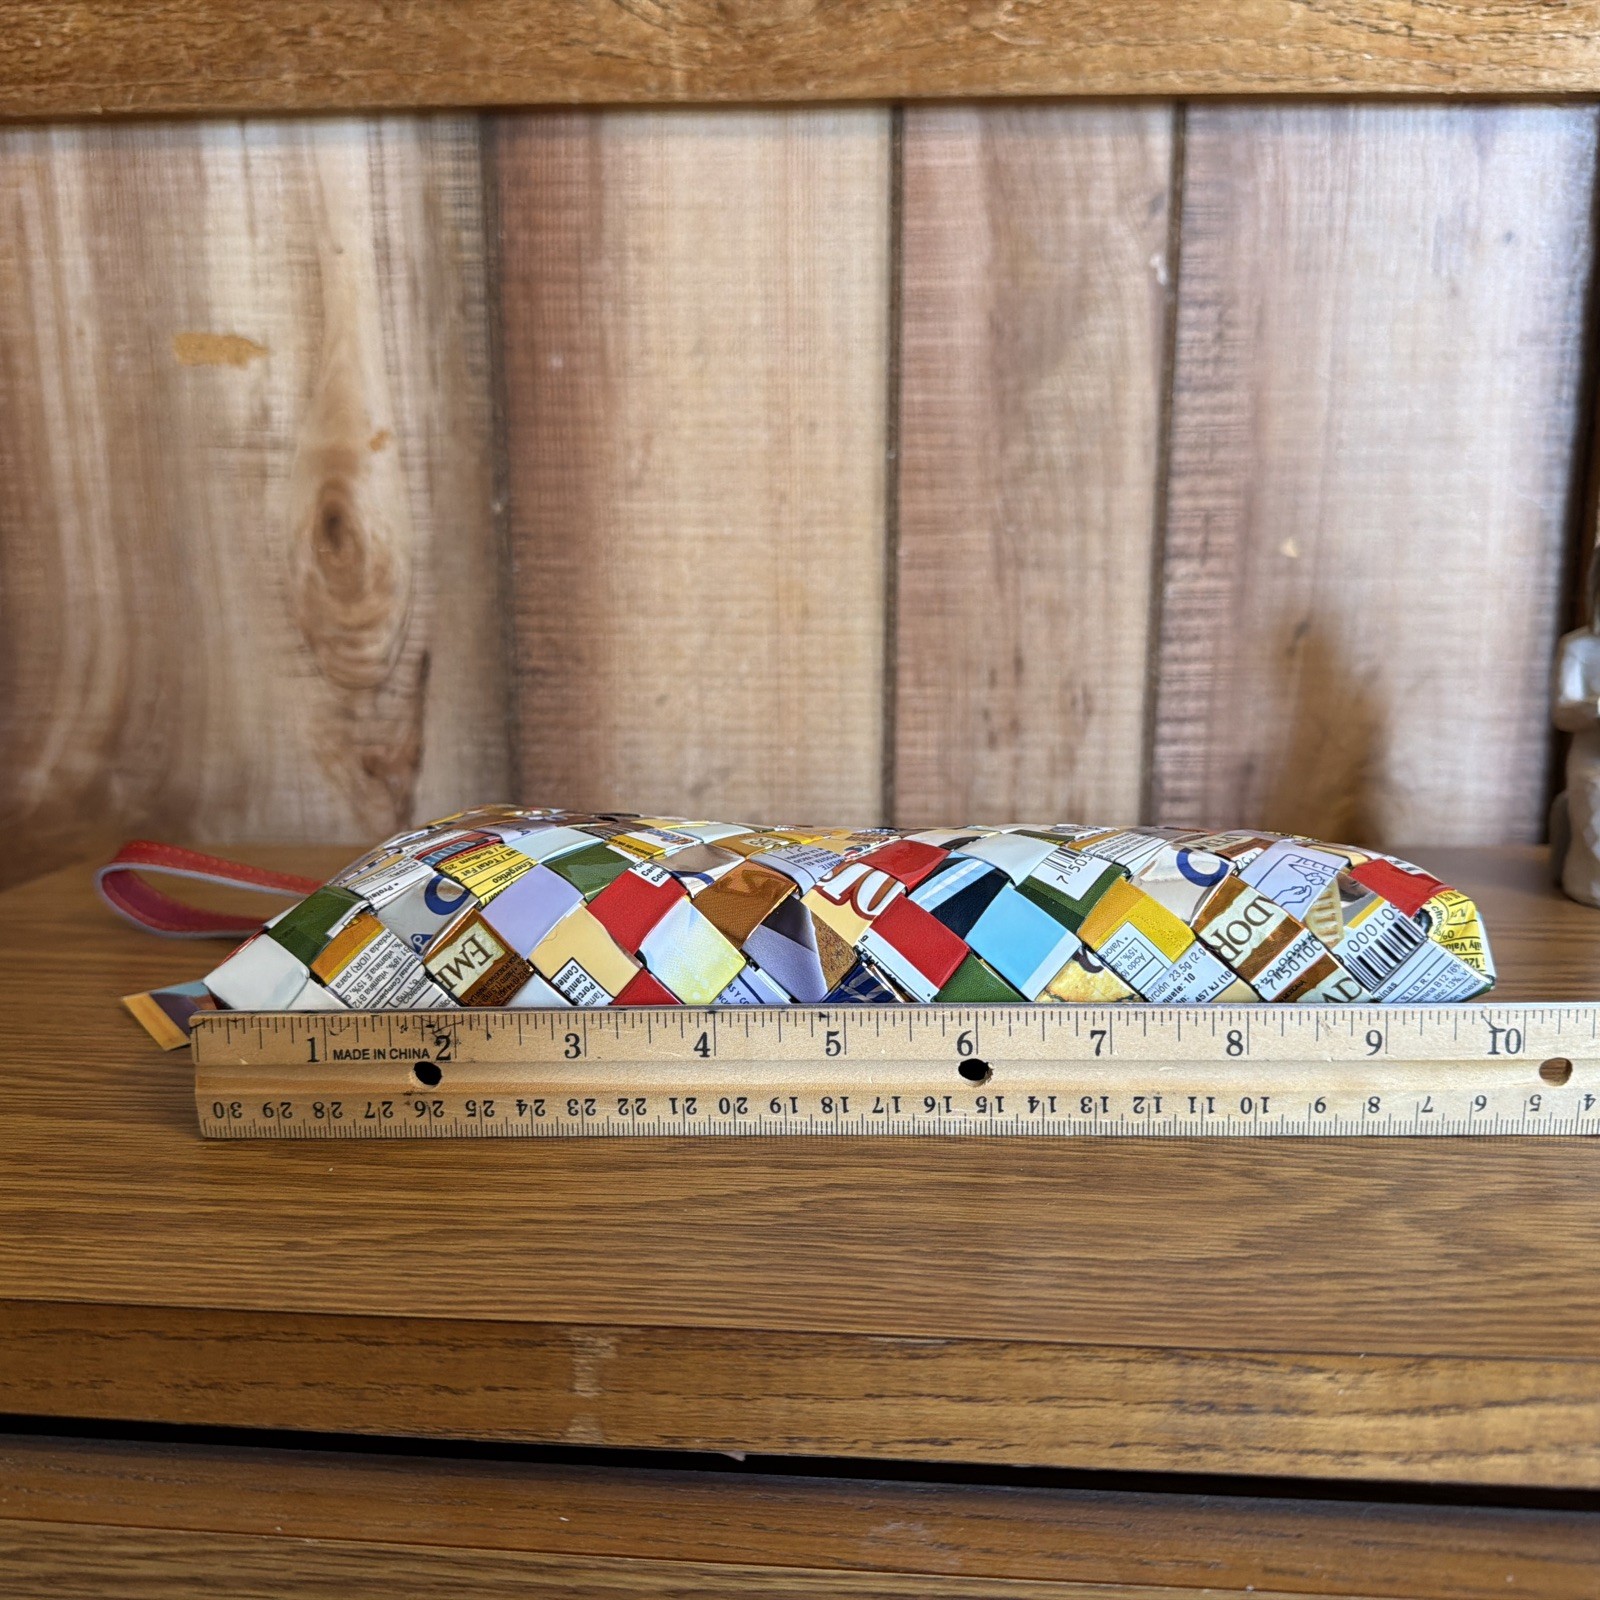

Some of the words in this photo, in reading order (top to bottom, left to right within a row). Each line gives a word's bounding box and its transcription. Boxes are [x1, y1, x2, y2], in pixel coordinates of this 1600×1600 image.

[476, 856, 500, 870] Total
[491, 859, 533, 885] Energético
[1055, 874, 1069, 888] 7
[1067, 849, 1093, 875] 503
[1211, 895, 1275, 963] DOR
[348, 950, 371, 974] (IDR)
[368, 948, 395, 976] vitamina
[1126, 951, 1148, 973] Ácido
[1168, 959, 1192, 983] 23,5g
[333, 968, 352, 990] para
[362, 969, 389, 997] vitamina
[1182, 971, 1196, 985] 10
[1434, 972, 1449, 988] B12
[1193, 988, 1209, 1004] 457
[1207, 980, 1219, 992] kJ
[307, 1037, 321, 1063] 1
[436, 1034, 452, 1061] 2
[565, 1033, 581, 1059] 3
[693, 1033, 711, 1057] 4
[825, 1031, 842, 1056] 5
[956, 1030, 973, 1056] 6
[1090, 1030, 1107, 1056] 7
[1226, 1030, 1244, 1056] 8
[1365, 1030, 1383, 1056] 9
[1488, 1028, 1522, 1055] 10
[333, 1048, 370, 1061] MADE
[374, 1048, 386, 1060] IN
[390, 1047, 429, 1060] CHINA
[213, 1101, 242, 1119] 30
[263, 1101, 292, 1119] 29
[313, 1101, 343, 1119] 28
[364, 1101, 393, 1119] 27
[414, 1100, 444, 1118] 26
[465, 1100, 494, 1118] 25
[517, 1099, 546, 1117] 24
[568, 1098, 596, 1116] 23
[618, 1098, 647, 1115] 22
[669, 1097, 698, 1115] 21
[719, 1097, 748, 1115] 20
[769, 1097, 798, 1114] 19
[821, 1097, 850, 1114] 18
[872, 1097, 901, 1114] 17
[924, 1096, 952, 1114] 16
[976, 1096, 1004, 1113] 15
[1028, 1096, 1057, 1113] 14
[1080, 1096, 1109, 1113] 13
[1133, 1096, 1163, 1113] 12
[1189, 1096, 1214, 1113] 11
[1240, 1096, 1269, 1113] 10
[1314, 1096, 1327, 1113] 9
[1367, 1096, 1381, 1113] 8
[1421, 1096, 1433, 1113] 7
[1474, 1095, 1487, 1112] 6
[1529, 1095, 1542, 1112] 5
[1583, 1094, 1597, 1111] 4
